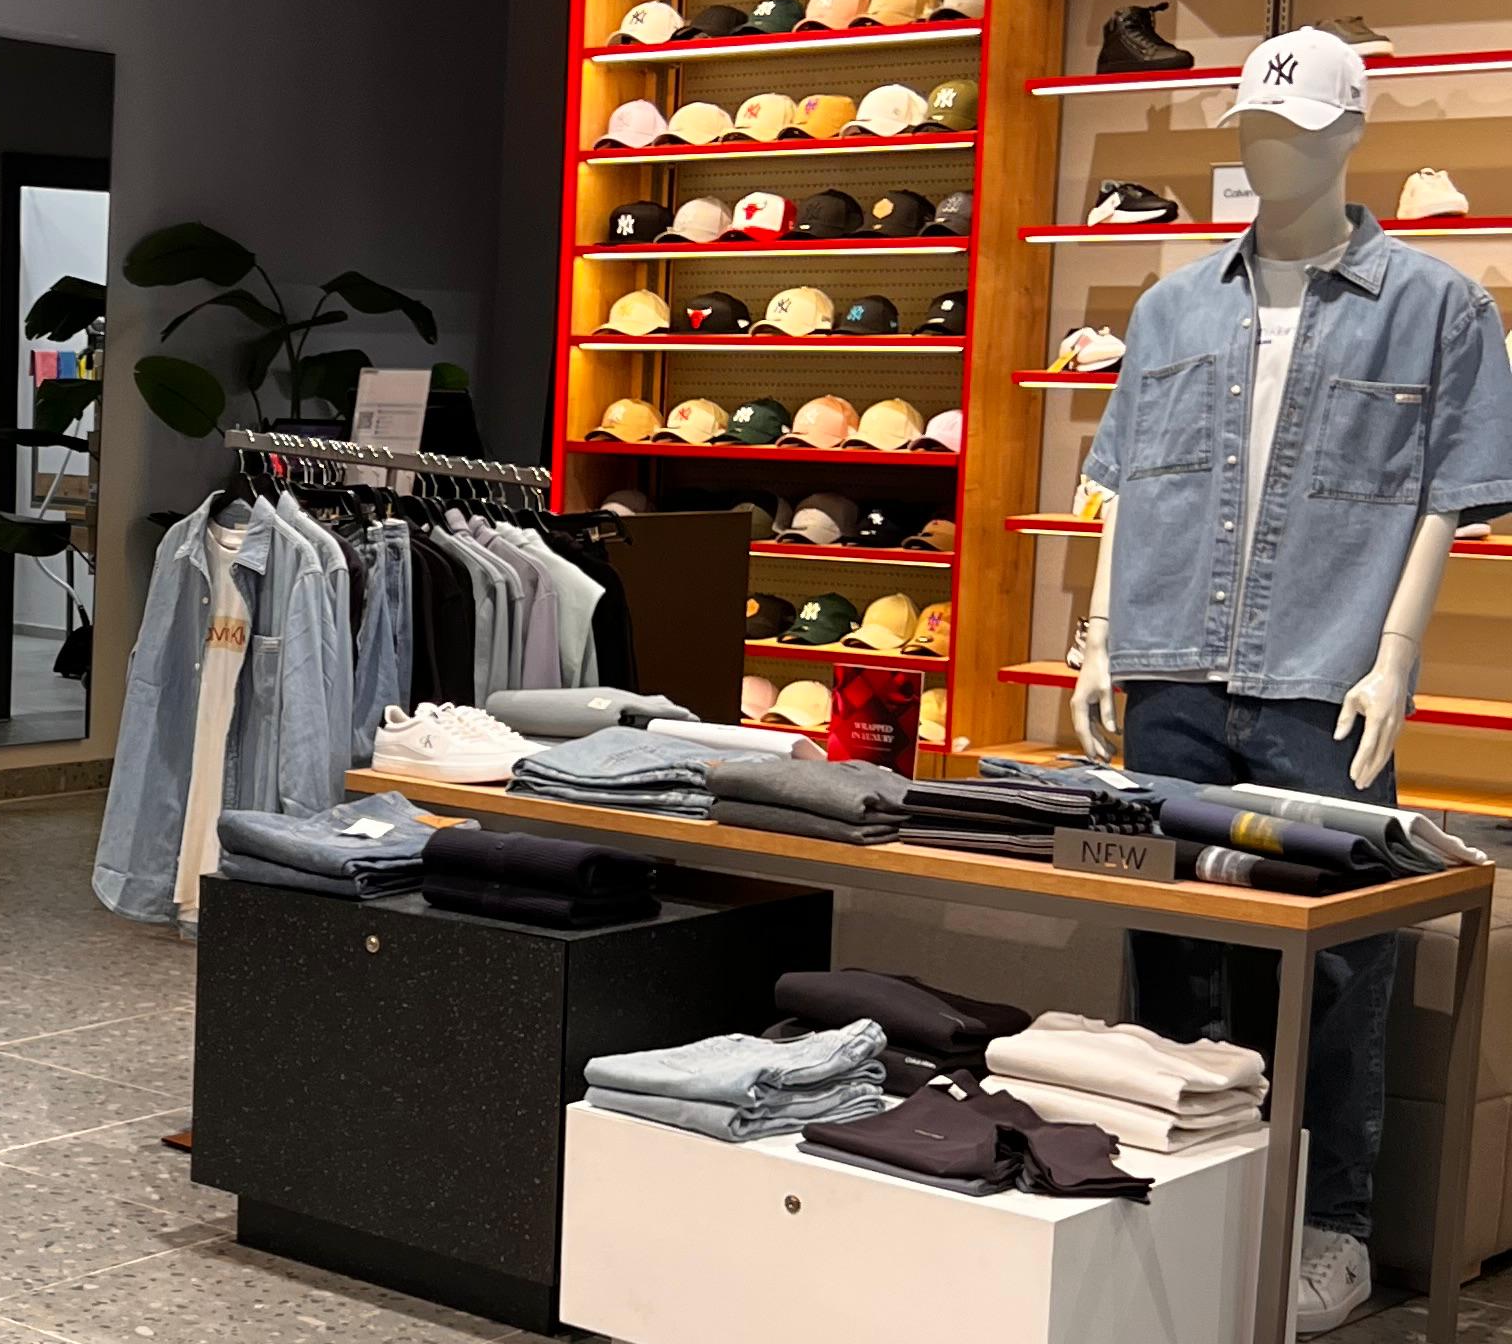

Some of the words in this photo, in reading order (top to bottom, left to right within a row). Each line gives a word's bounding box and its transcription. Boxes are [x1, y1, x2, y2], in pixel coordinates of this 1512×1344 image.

[1263, 53, 1299, 86] NY
[616, 214, 635, 236] NY
[1081, 840, 1148, 871] NEW
